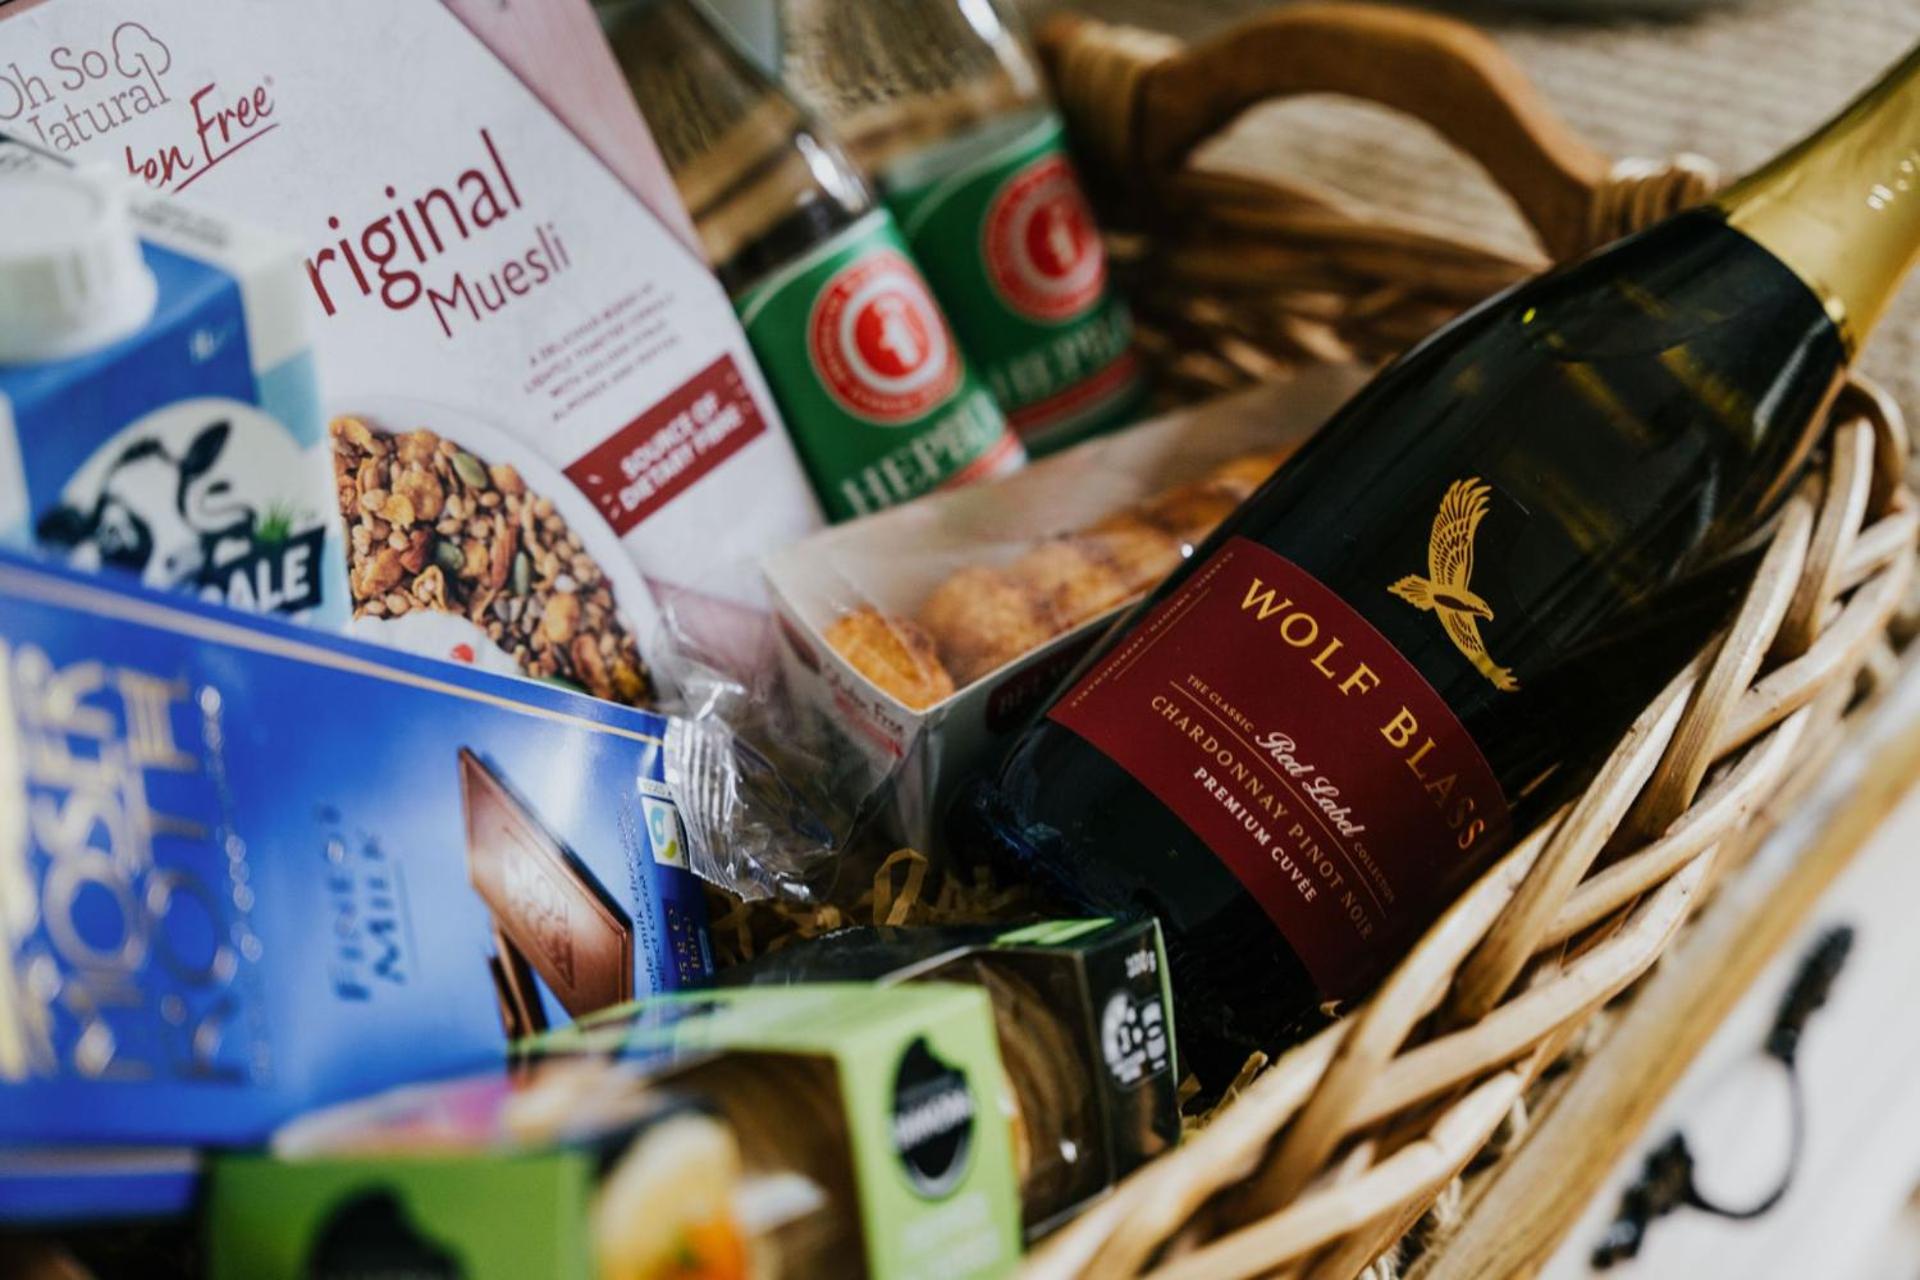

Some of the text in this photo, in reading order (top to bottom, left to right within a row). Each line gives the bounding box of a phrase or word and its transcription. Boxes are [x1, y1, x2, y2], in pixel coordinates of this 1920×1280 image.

[0, 47, 108, 120] Oh So
[190, 82, 275, 164] Free
[305, 128, 522, 316] riginal
[427, 223, 570, 338] Muesli
[618, 442, 696, 513] DIETARY
[620, 390, 719, 481] SOURCE OF
[1187, 674, 1209, 694] THE
[1208, 692, 1255, 733] CLASSIC
[1255, 731, 1315, 777] Red
[1302, 776, 1365, 838] Label
[1241, 577, 1485, 849] WOLF BLASS
[1151, 696, 1373, 940] CHARDONNAY PINOT NOIR
[1193, 767, 1317, 902] PREMIUM CUVÉE
